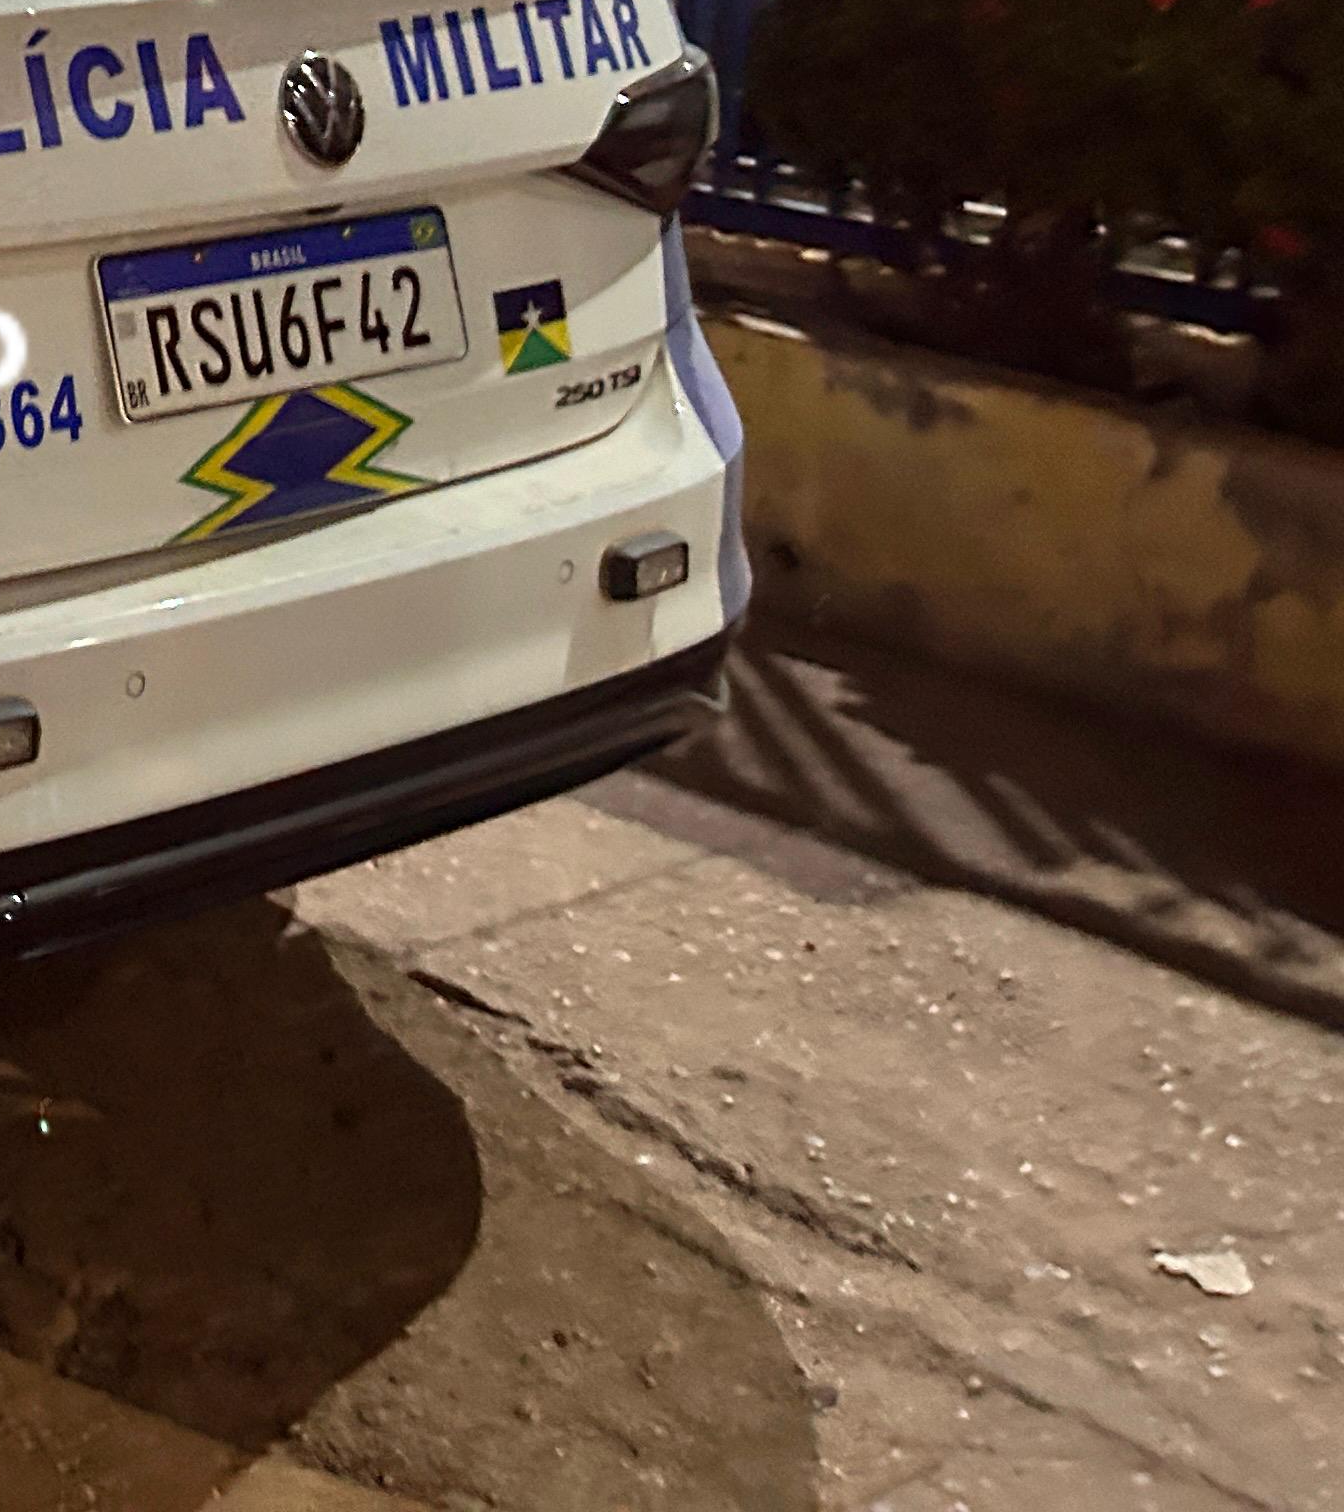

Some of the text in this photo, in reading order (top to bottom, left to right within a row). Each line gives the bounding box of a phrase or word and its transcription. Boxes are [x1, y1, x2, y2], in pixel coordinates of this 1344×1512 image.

[250, 244, 307, 272] BRASIL
[146, 264, 431, 395] RSU6F42
[127, 378, 150, 408] BR
[555, 379, 605, 407] 250
